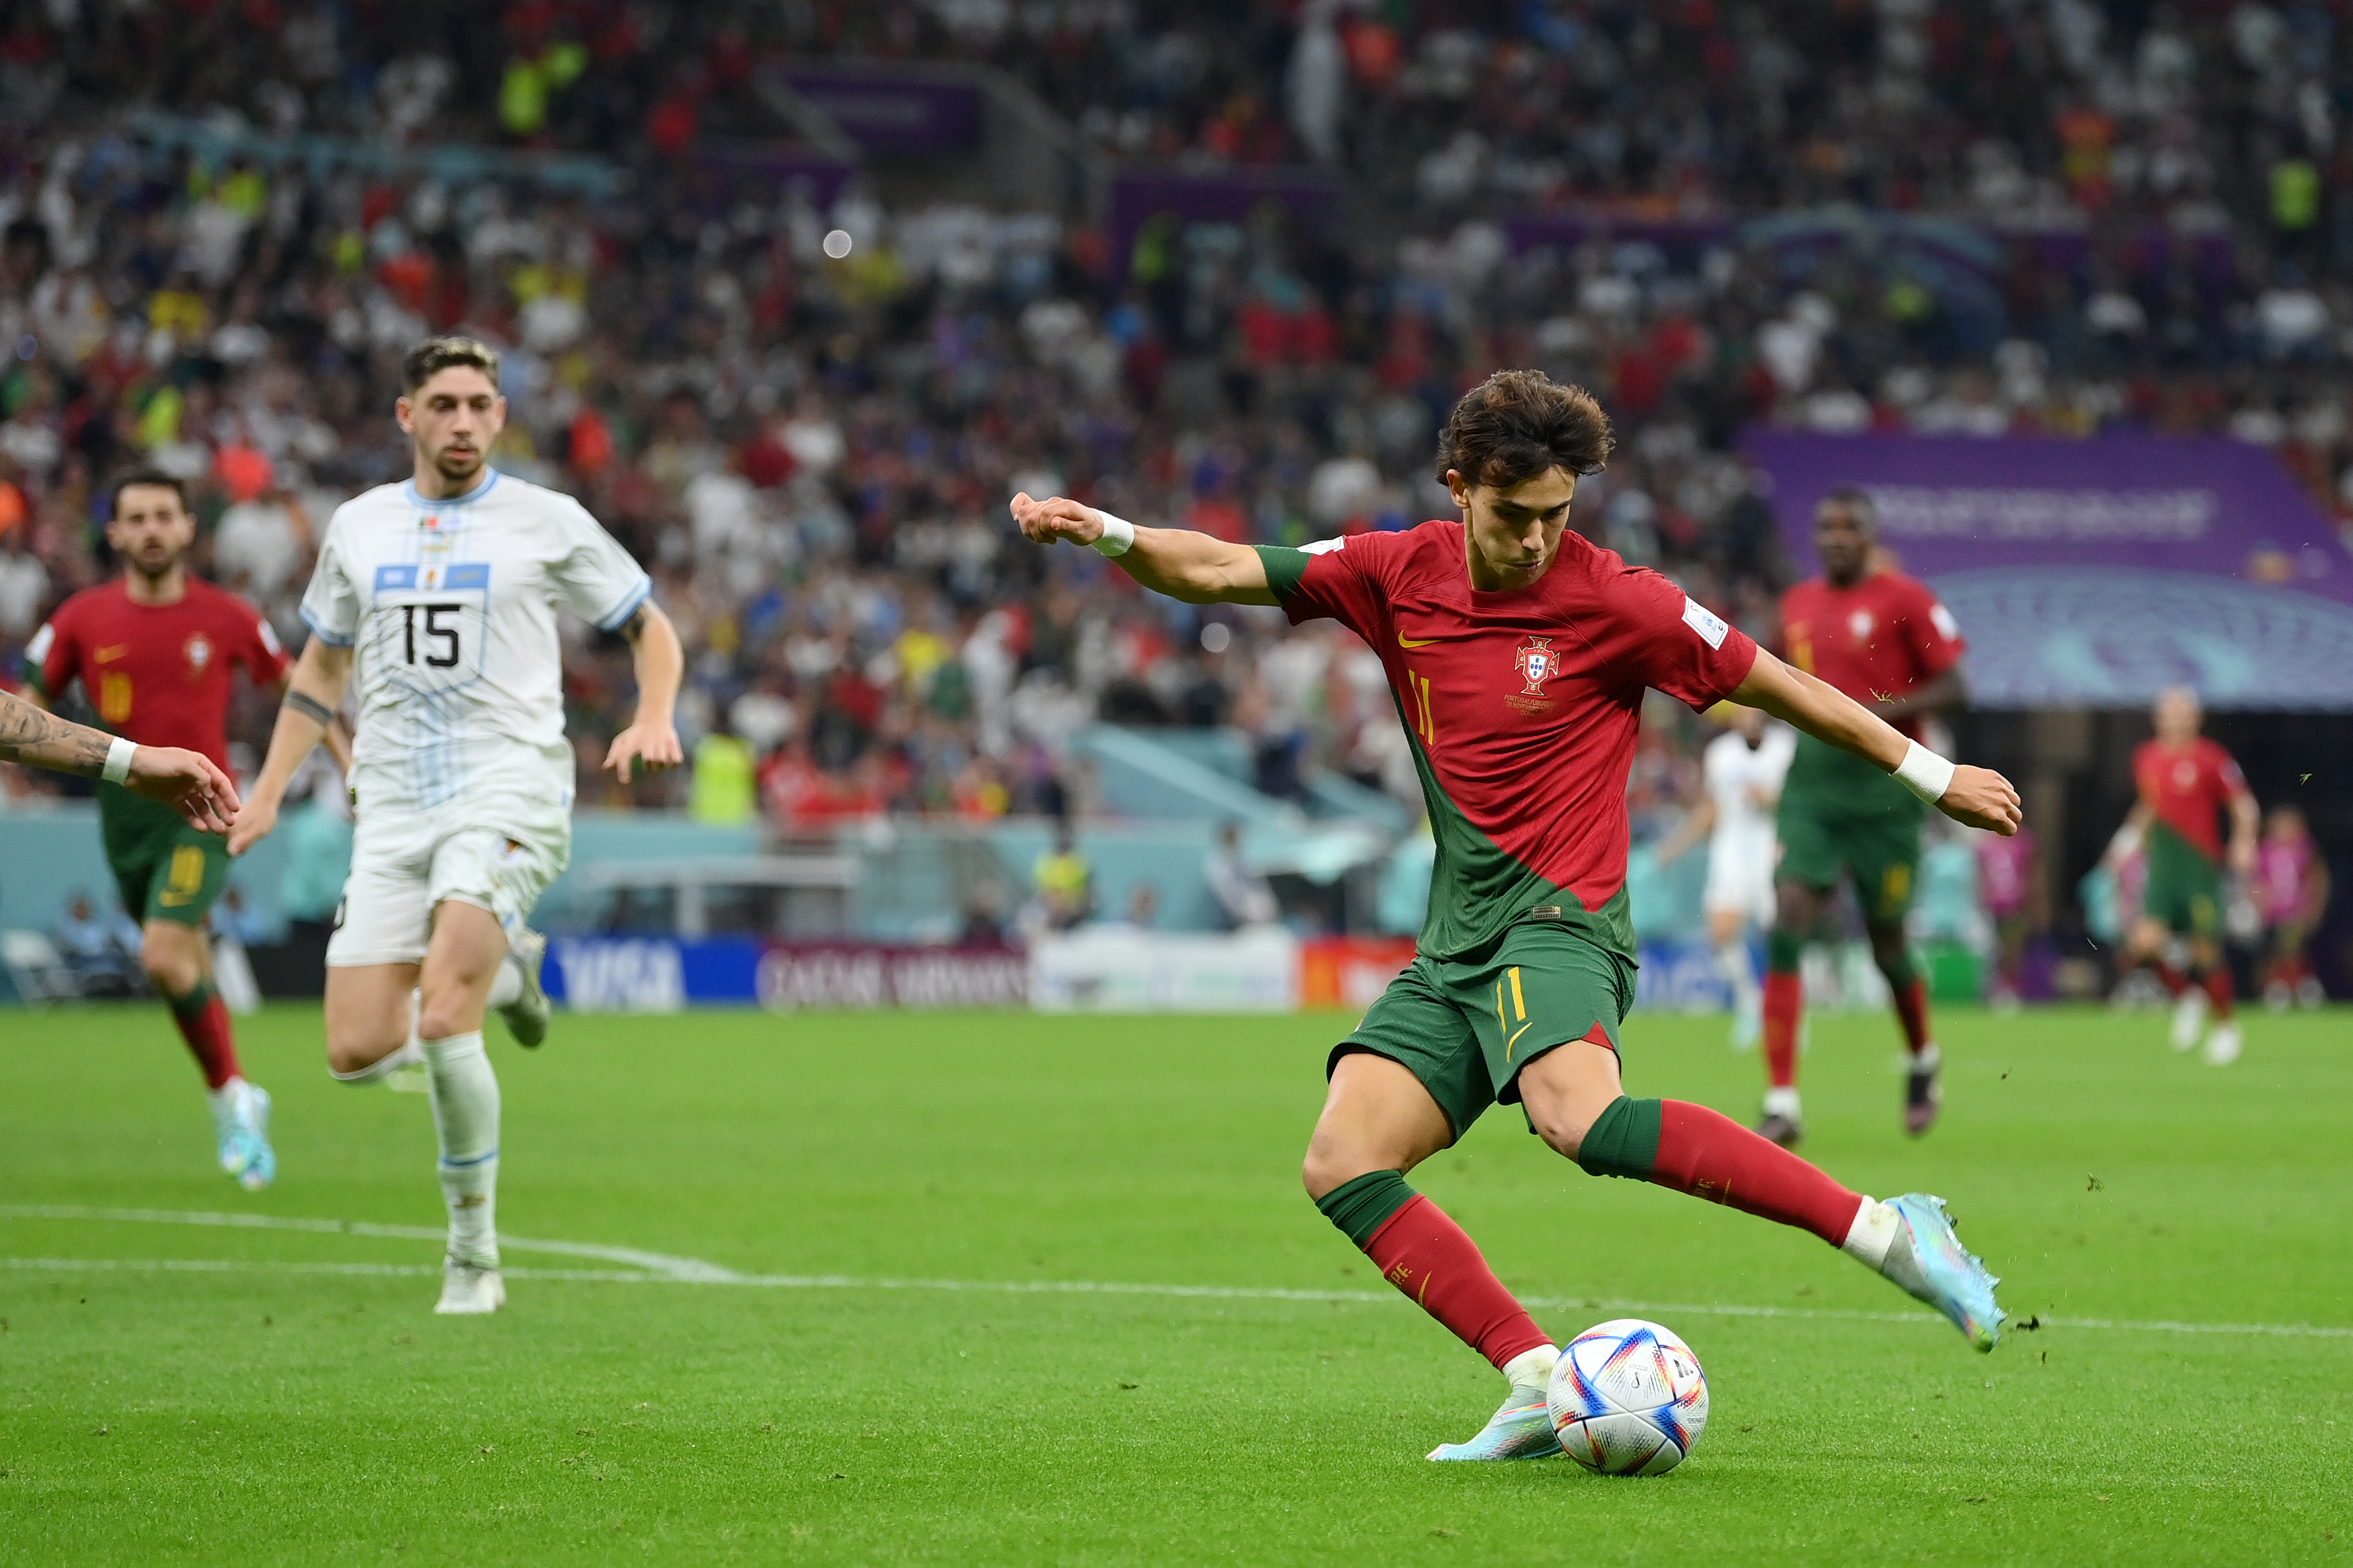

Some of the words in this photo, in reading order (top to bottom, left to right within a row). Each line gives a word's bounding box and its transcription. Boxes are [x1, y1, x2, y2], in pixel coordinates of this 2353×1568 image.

[403, 603, 460, 666] 15
[1408, 669, 1434, 746] 11
[558, 937, 685, 1011] VISA
[1496, 966, 1526, 1034] 11
